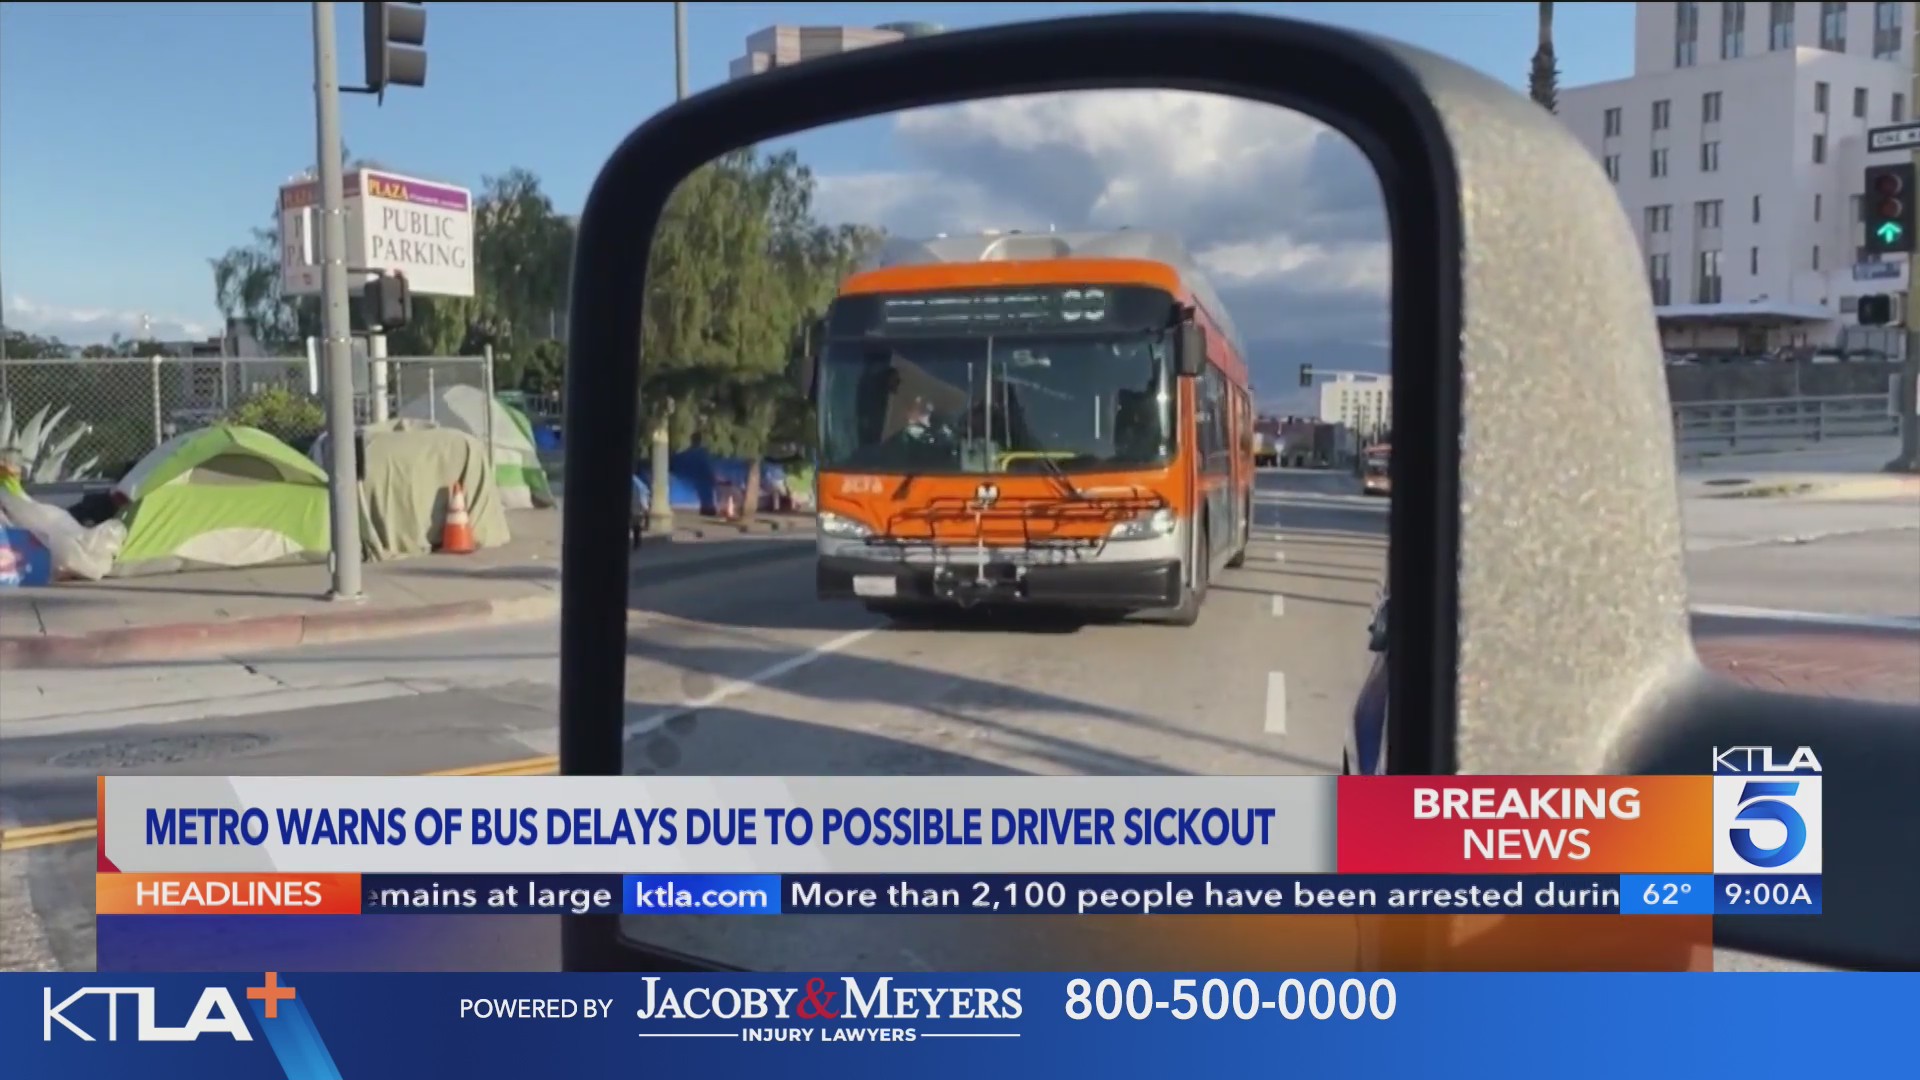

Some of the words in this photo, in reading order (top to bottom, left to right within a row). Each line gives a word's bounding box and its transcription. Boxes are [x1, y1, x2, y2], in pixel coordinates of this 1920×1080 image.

[369, 178, 409, 201] PLAZA
[383, 206, 455, 240] PUBLIC
[371, 235, 466, 269] PARKING
